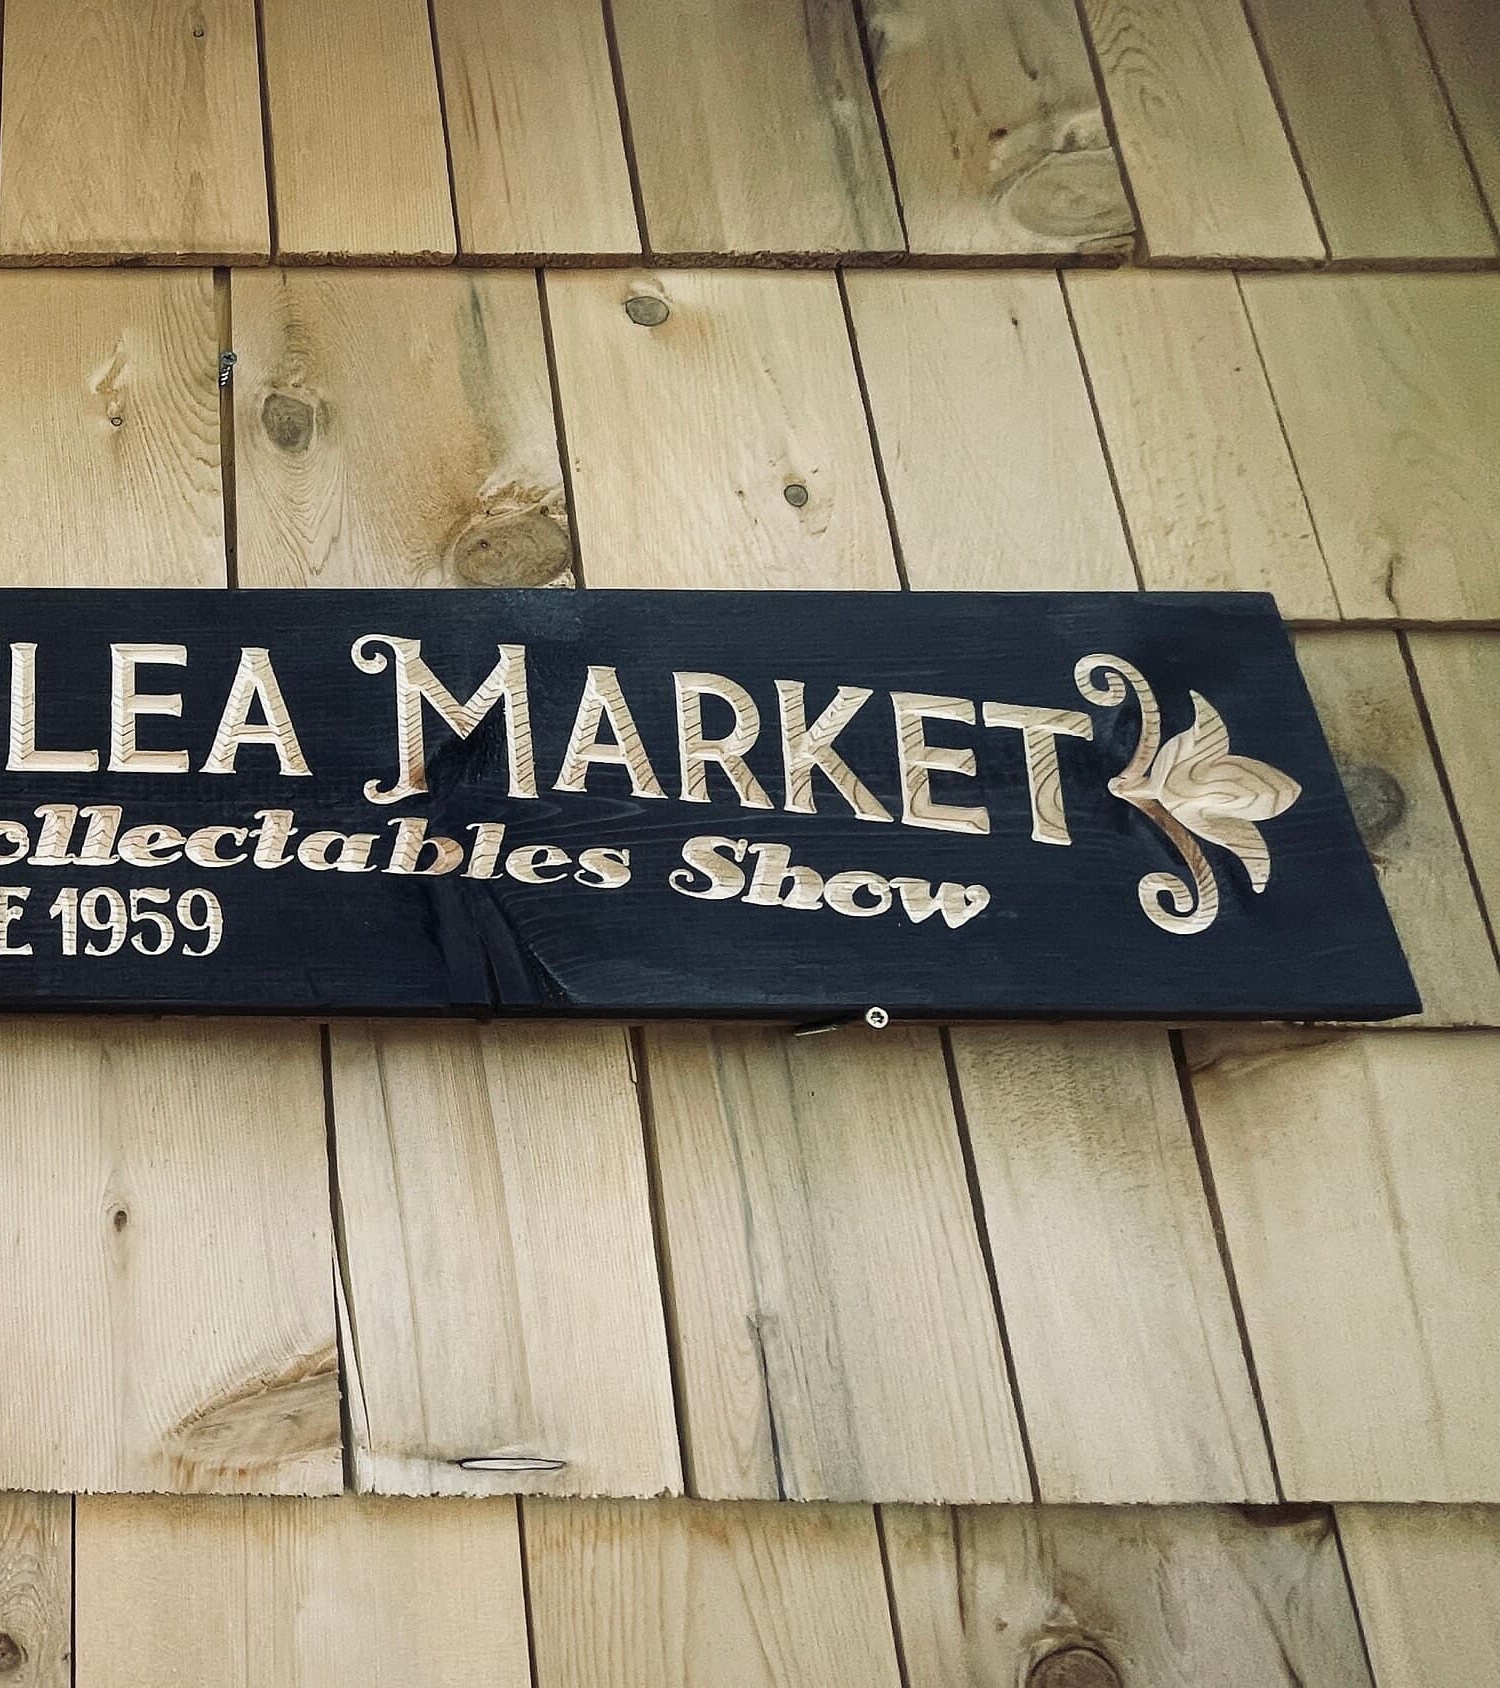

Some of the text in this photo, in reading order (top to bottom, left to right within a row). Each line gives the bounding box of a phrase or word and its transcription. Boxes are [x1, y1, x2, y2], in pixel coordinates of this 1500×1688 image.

[351, 634, 1093, 845] MARKET
[49, 887, 223, 957] 1959
[669, 836, 990, 928] Show
